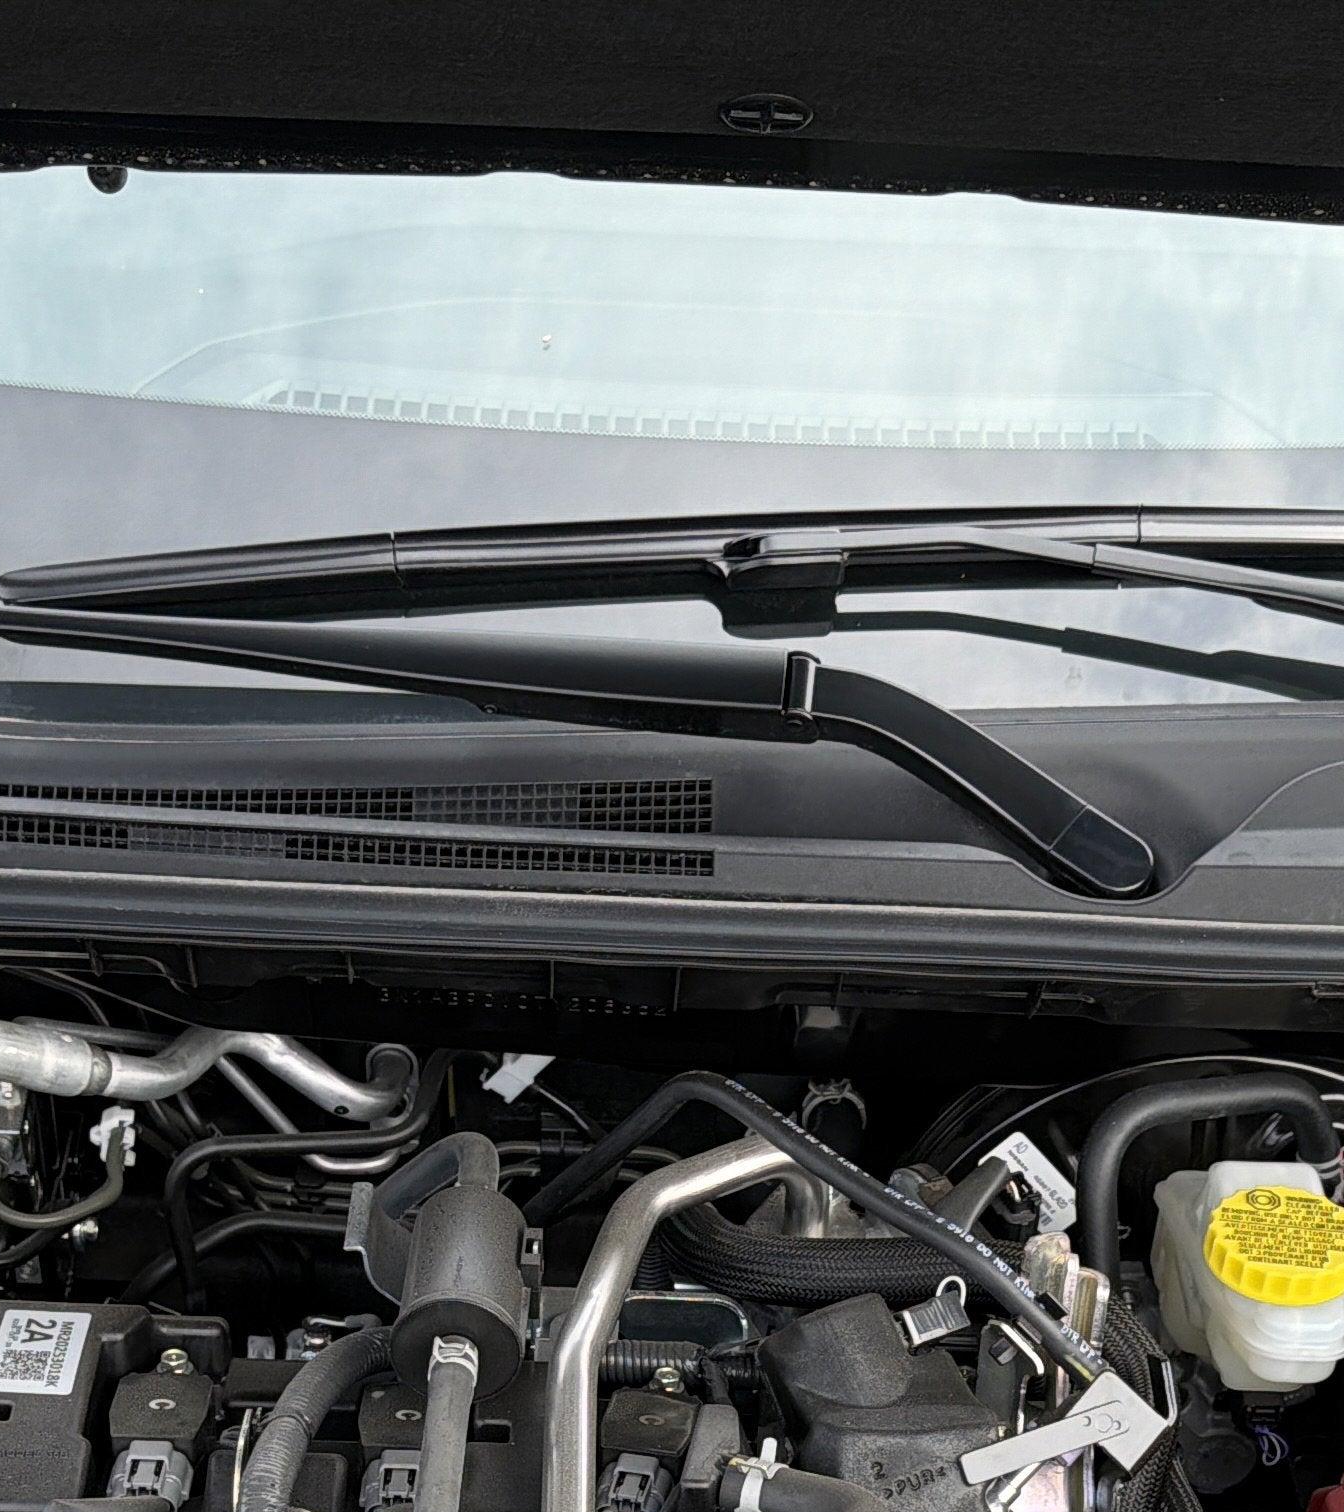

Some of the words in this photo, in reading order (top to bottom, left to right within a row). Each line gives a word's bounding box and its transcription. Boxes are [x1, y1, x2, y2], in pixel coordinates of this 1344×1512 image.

[976, 1243, 992, 1257] DO
[993, 1257, 1013, 1275] NOT
[20, 1318, 57, 1344] 2A
